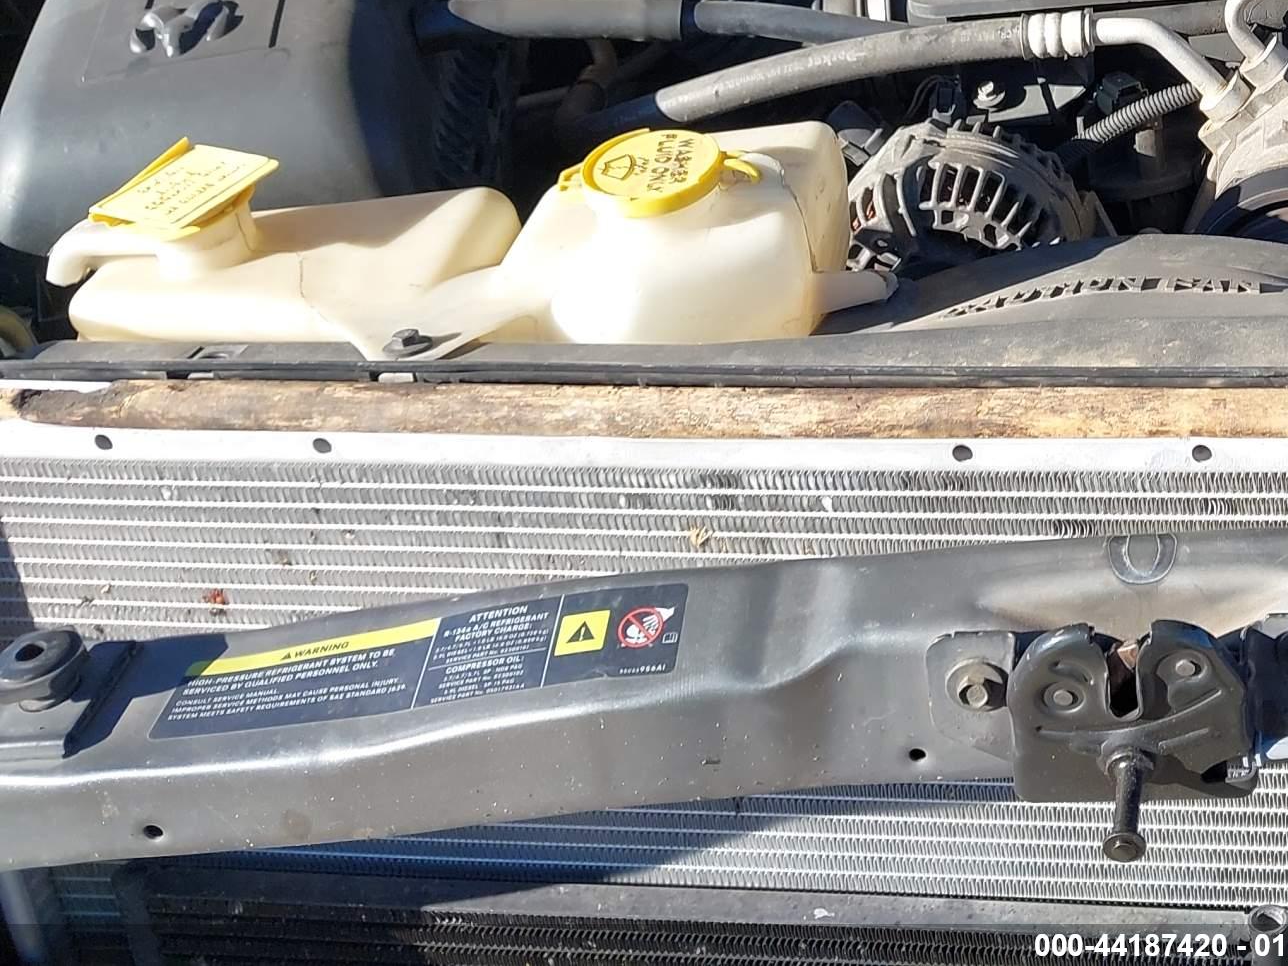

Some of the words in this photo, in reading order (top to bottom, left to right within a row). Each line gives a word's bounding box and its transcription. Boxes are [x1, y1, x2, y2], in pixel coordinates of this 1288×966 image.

[654, 134, 678, 164] FLUID
[646, 166, 670, 193] ONLY
[1163, 277, 1261, 294] FAN
[469, 605, 529, 624] ATTENTION
[472, 621, 489, 632] A/C
[490, 612, 549, 628] REFRIGERANT
[454, 629, 493, 642] FACTORY
[294, 641, 350, 659] WARNING
[265, 660, 329, 677] REFRIGERANT
[329, 653, 366, 666] SYSTEM
[369, 650, 381, 659] TO
[382, 648, 396, 657] BE
[445, 657, 504, 674] COMPRESSOR
[183, 684, 229, 696] SERVICED
[230, 681, 245, 691] BY
[244, 673, 293, 689] QUALIFIED
[295, 665, 350, 680] PERSONNEL
[352, 660, 379, 671] ONLY.
[167, 712, 199, 721] SYSTEM
[199, 709, 225, 718] MEETS
[225, 705, 255, 715] SAFETY
[255, 697, 316, 710] REQUIREMENTS
[316, 695, 328, 703] OF
[329, 693, 345, 701] SAE
[345, 687, 386, 699] STANDARD
[171, 704, 212, 714] IMPROPER
[212, 700, 245, 710] SERVICE
[245, 695, 284, 705] METHODS
[285, 691, 301, 700] MAY
[302, 687, 328, 697] CAUSE
[329, 682, 369, 693] PERSONAL
[176, 697, 211, 707] CONSULT
[213, 693, 245, 703] SERVICE
